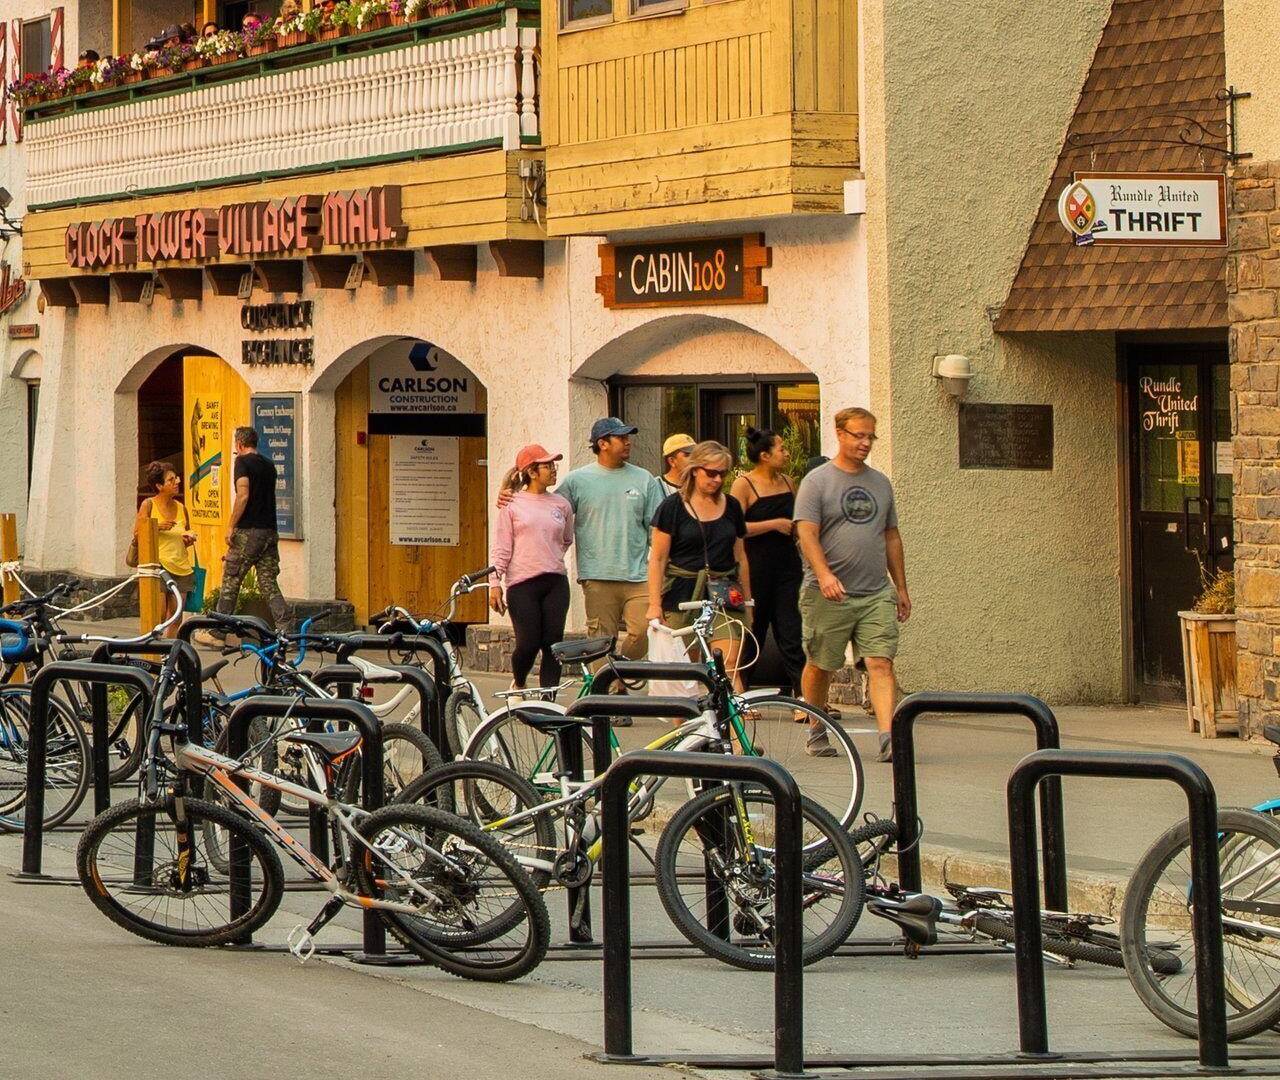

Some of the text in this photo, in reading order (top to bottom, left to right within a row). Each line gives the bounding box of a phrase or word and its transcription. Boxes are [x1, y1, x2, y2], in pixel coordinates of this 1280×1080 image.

[1109, 185, 1200, 207] Rundle United
[1109, 209, 1202, 232] THRIFT
[65, 187, 402, 268] CLOCK TOWER VILLAGE MALL
[241, 339, 314, 366] EXCHANGE
[378, 378, 468, 393] CARLSON
[1140, 377, 1181, 399] Rundle
[206, 401, 219, 410] BANFF
[389, 395, 459, 404] CONSTRUCTION
[1158, 395, 1198, 413] United
[256, 404, 275, 419] Currency
[390, 404, 457, 412] www.avcarlson.ca
[211, 411, 219, 420] AVE
[201, 421, 219, 430] BREWING
[1143, 412, 1180, 434] Thrift
[213, 432, 219, 440] CO
[208, 490, 219, 498] OPEN
[204, 500, 219, 508] DURING
[192, 510, 220, 519] CONSTRUCTION
